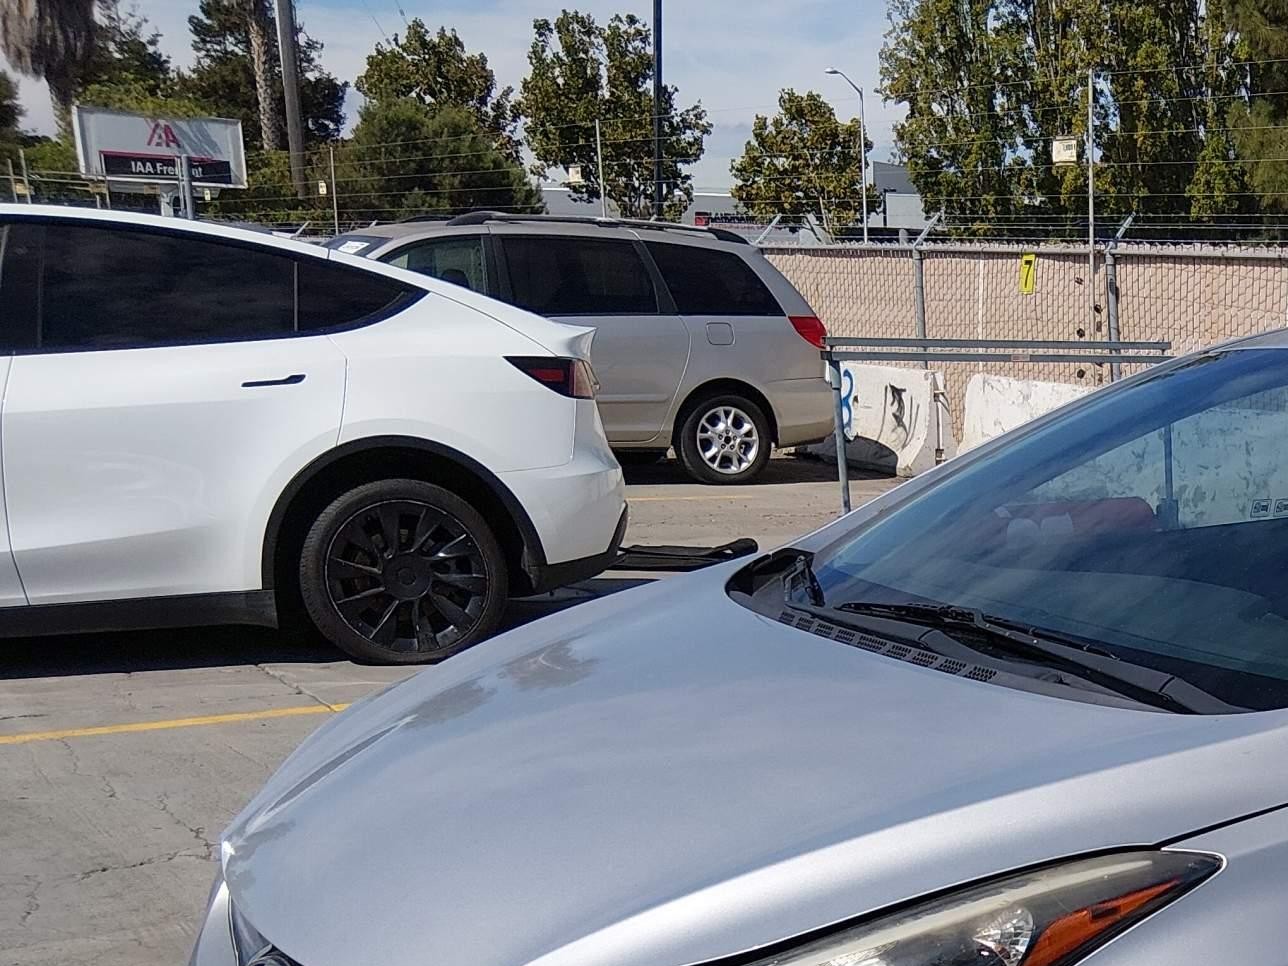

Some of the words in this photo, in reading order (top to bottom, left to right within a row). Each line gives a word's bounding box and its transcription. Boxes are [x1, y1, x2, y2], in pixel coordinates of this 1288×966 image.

[131, 161, 155, 174] IAA
[156, 163, 203, 178] Frent
[1023, 259, 1033, 289] 7
